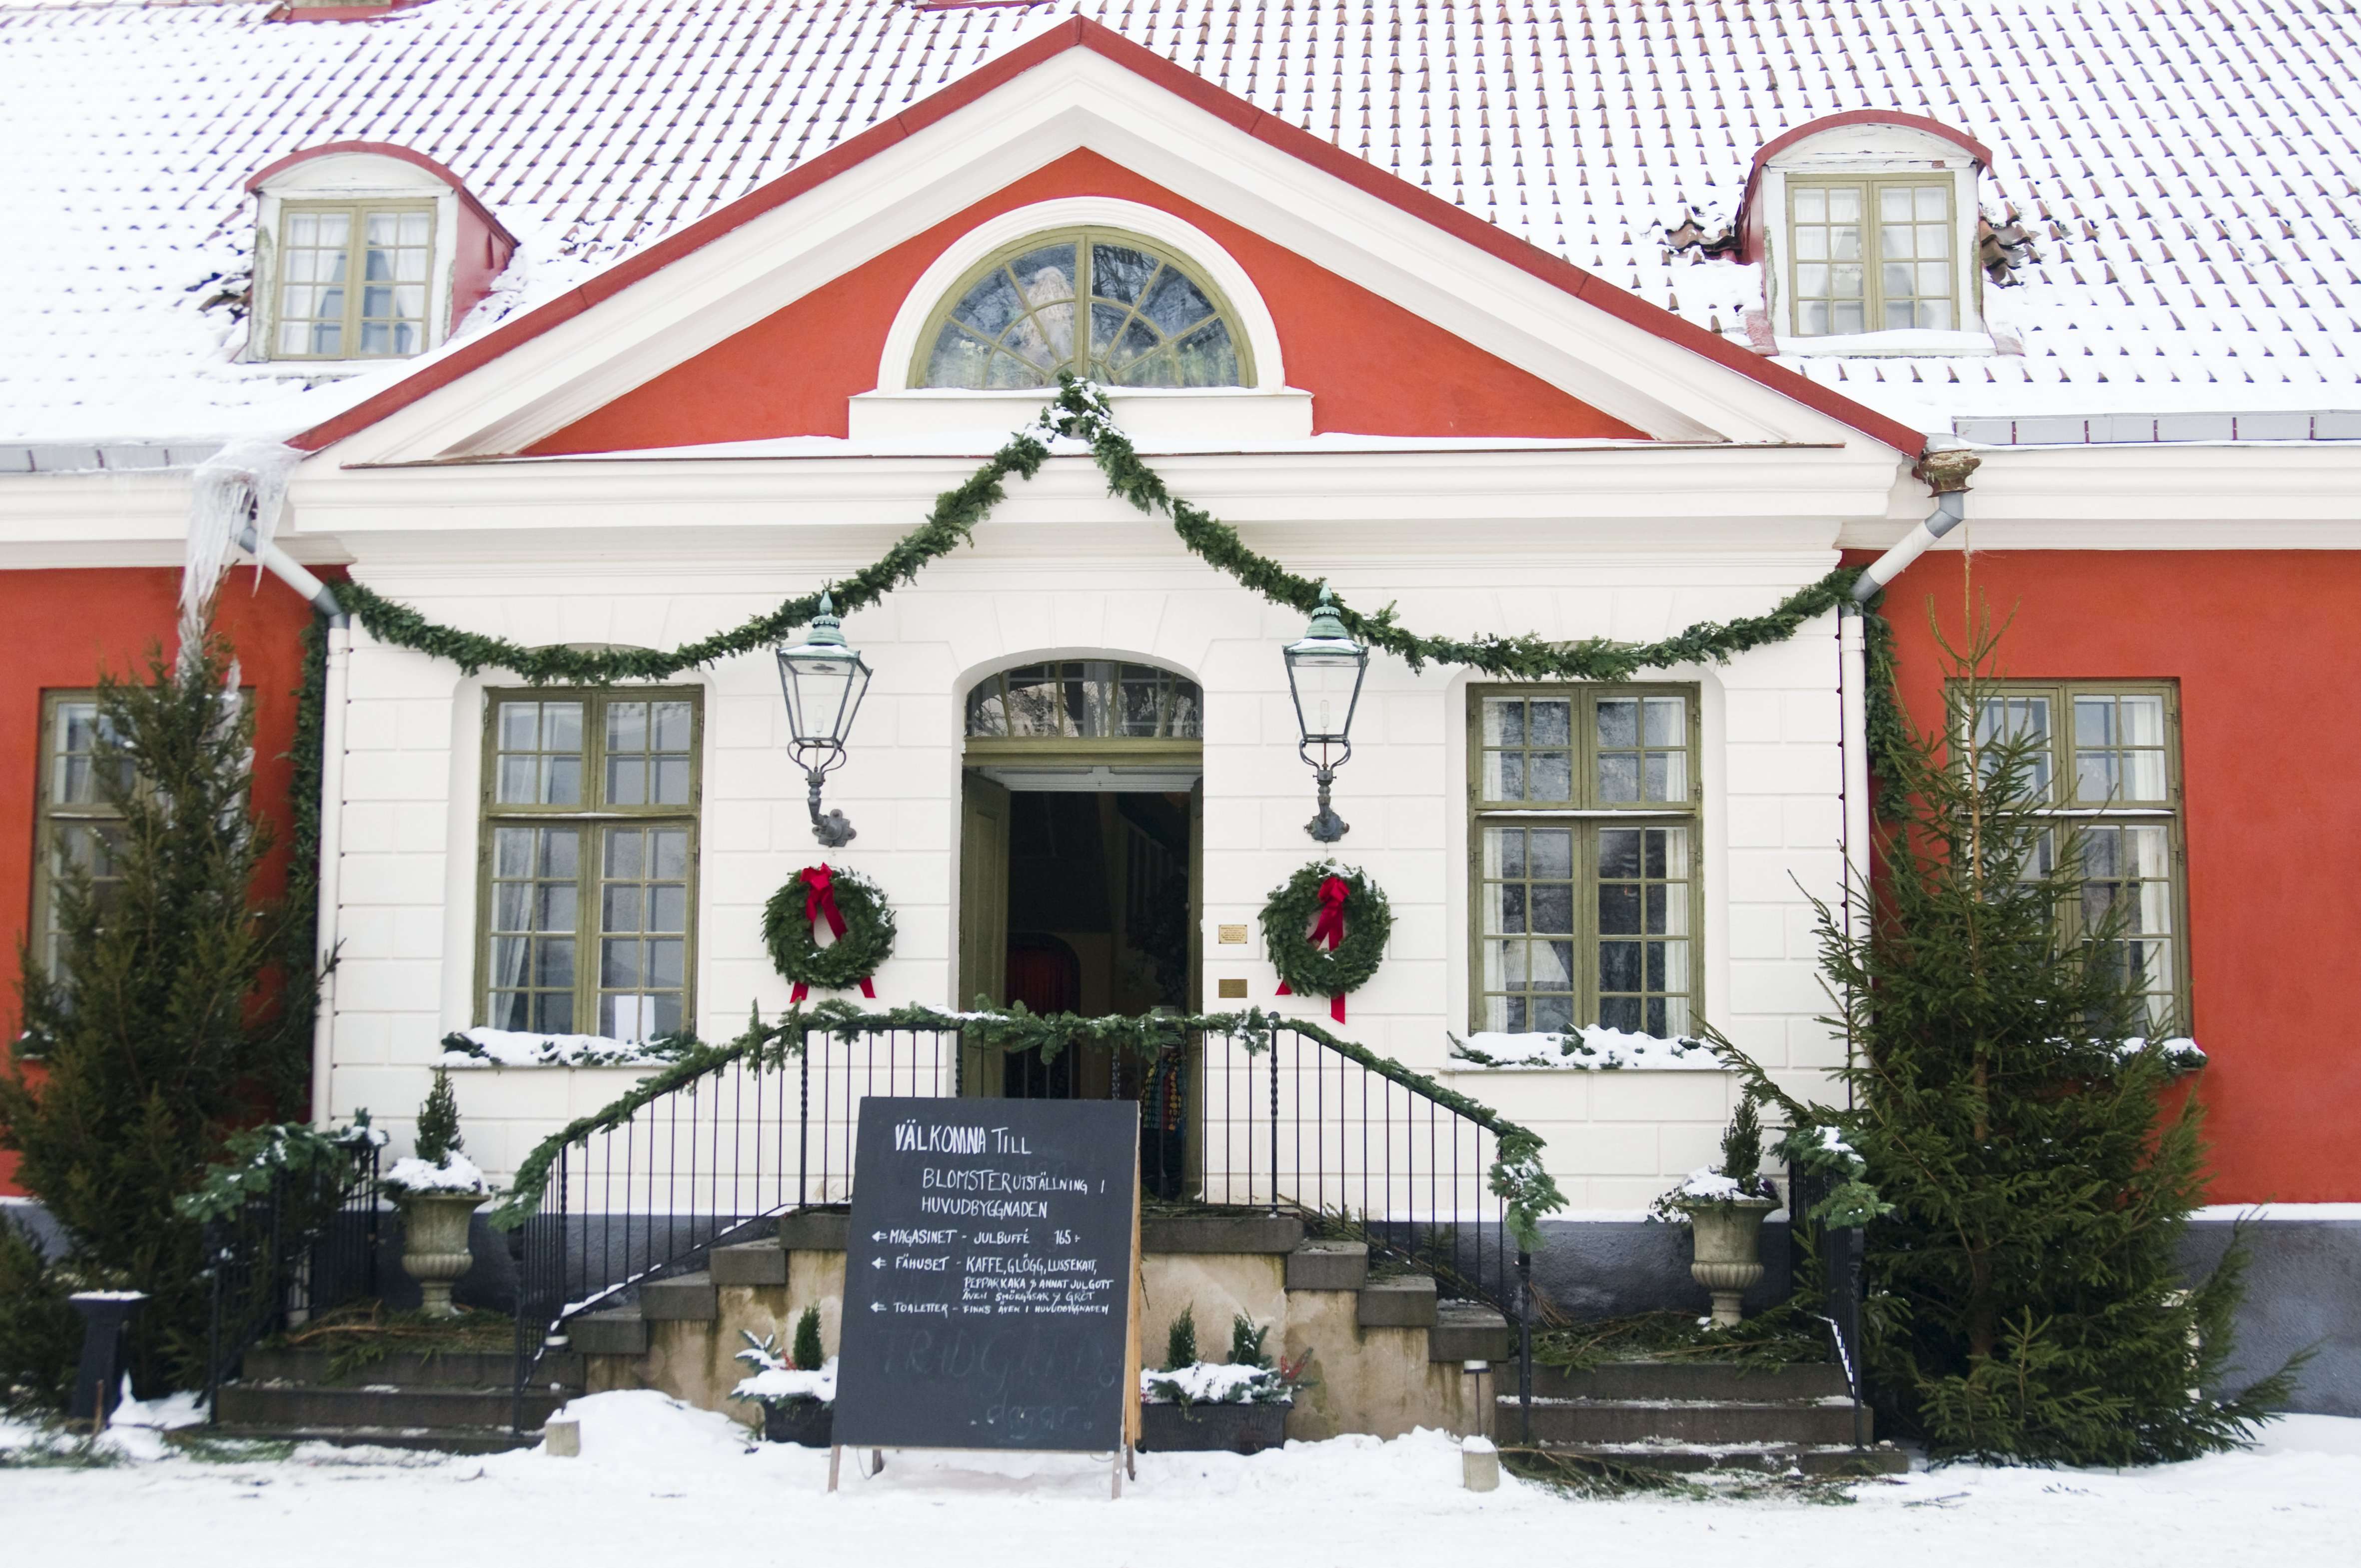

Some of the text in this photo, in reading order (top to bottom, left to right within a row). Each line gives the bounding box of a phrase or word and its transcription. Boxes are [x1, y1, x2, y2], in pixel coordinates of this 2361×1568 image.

[895, 1119, 1032, 1154] VÄLKOMNA TILL
[922, 1167, 1105, 1195] BLOMSTERUTSTÄLLNING I
[922, 1196, 1048, 1220] HUVUDBYGGNADEN
[889, 1229, 958, 1247] MAGASINET
[974, 1228, 1030, 1245] JULBUFFÉ
[895, 1253, 950, 1271] FÄHUSET
[1039, 1279, 1069, 1289] ANNAT
[1065, 1289, 1096, 1305] GRÖT
[893, 1302, 949, 1319] TOALETTER
[963, 1305, 991, 1314] FINNS
